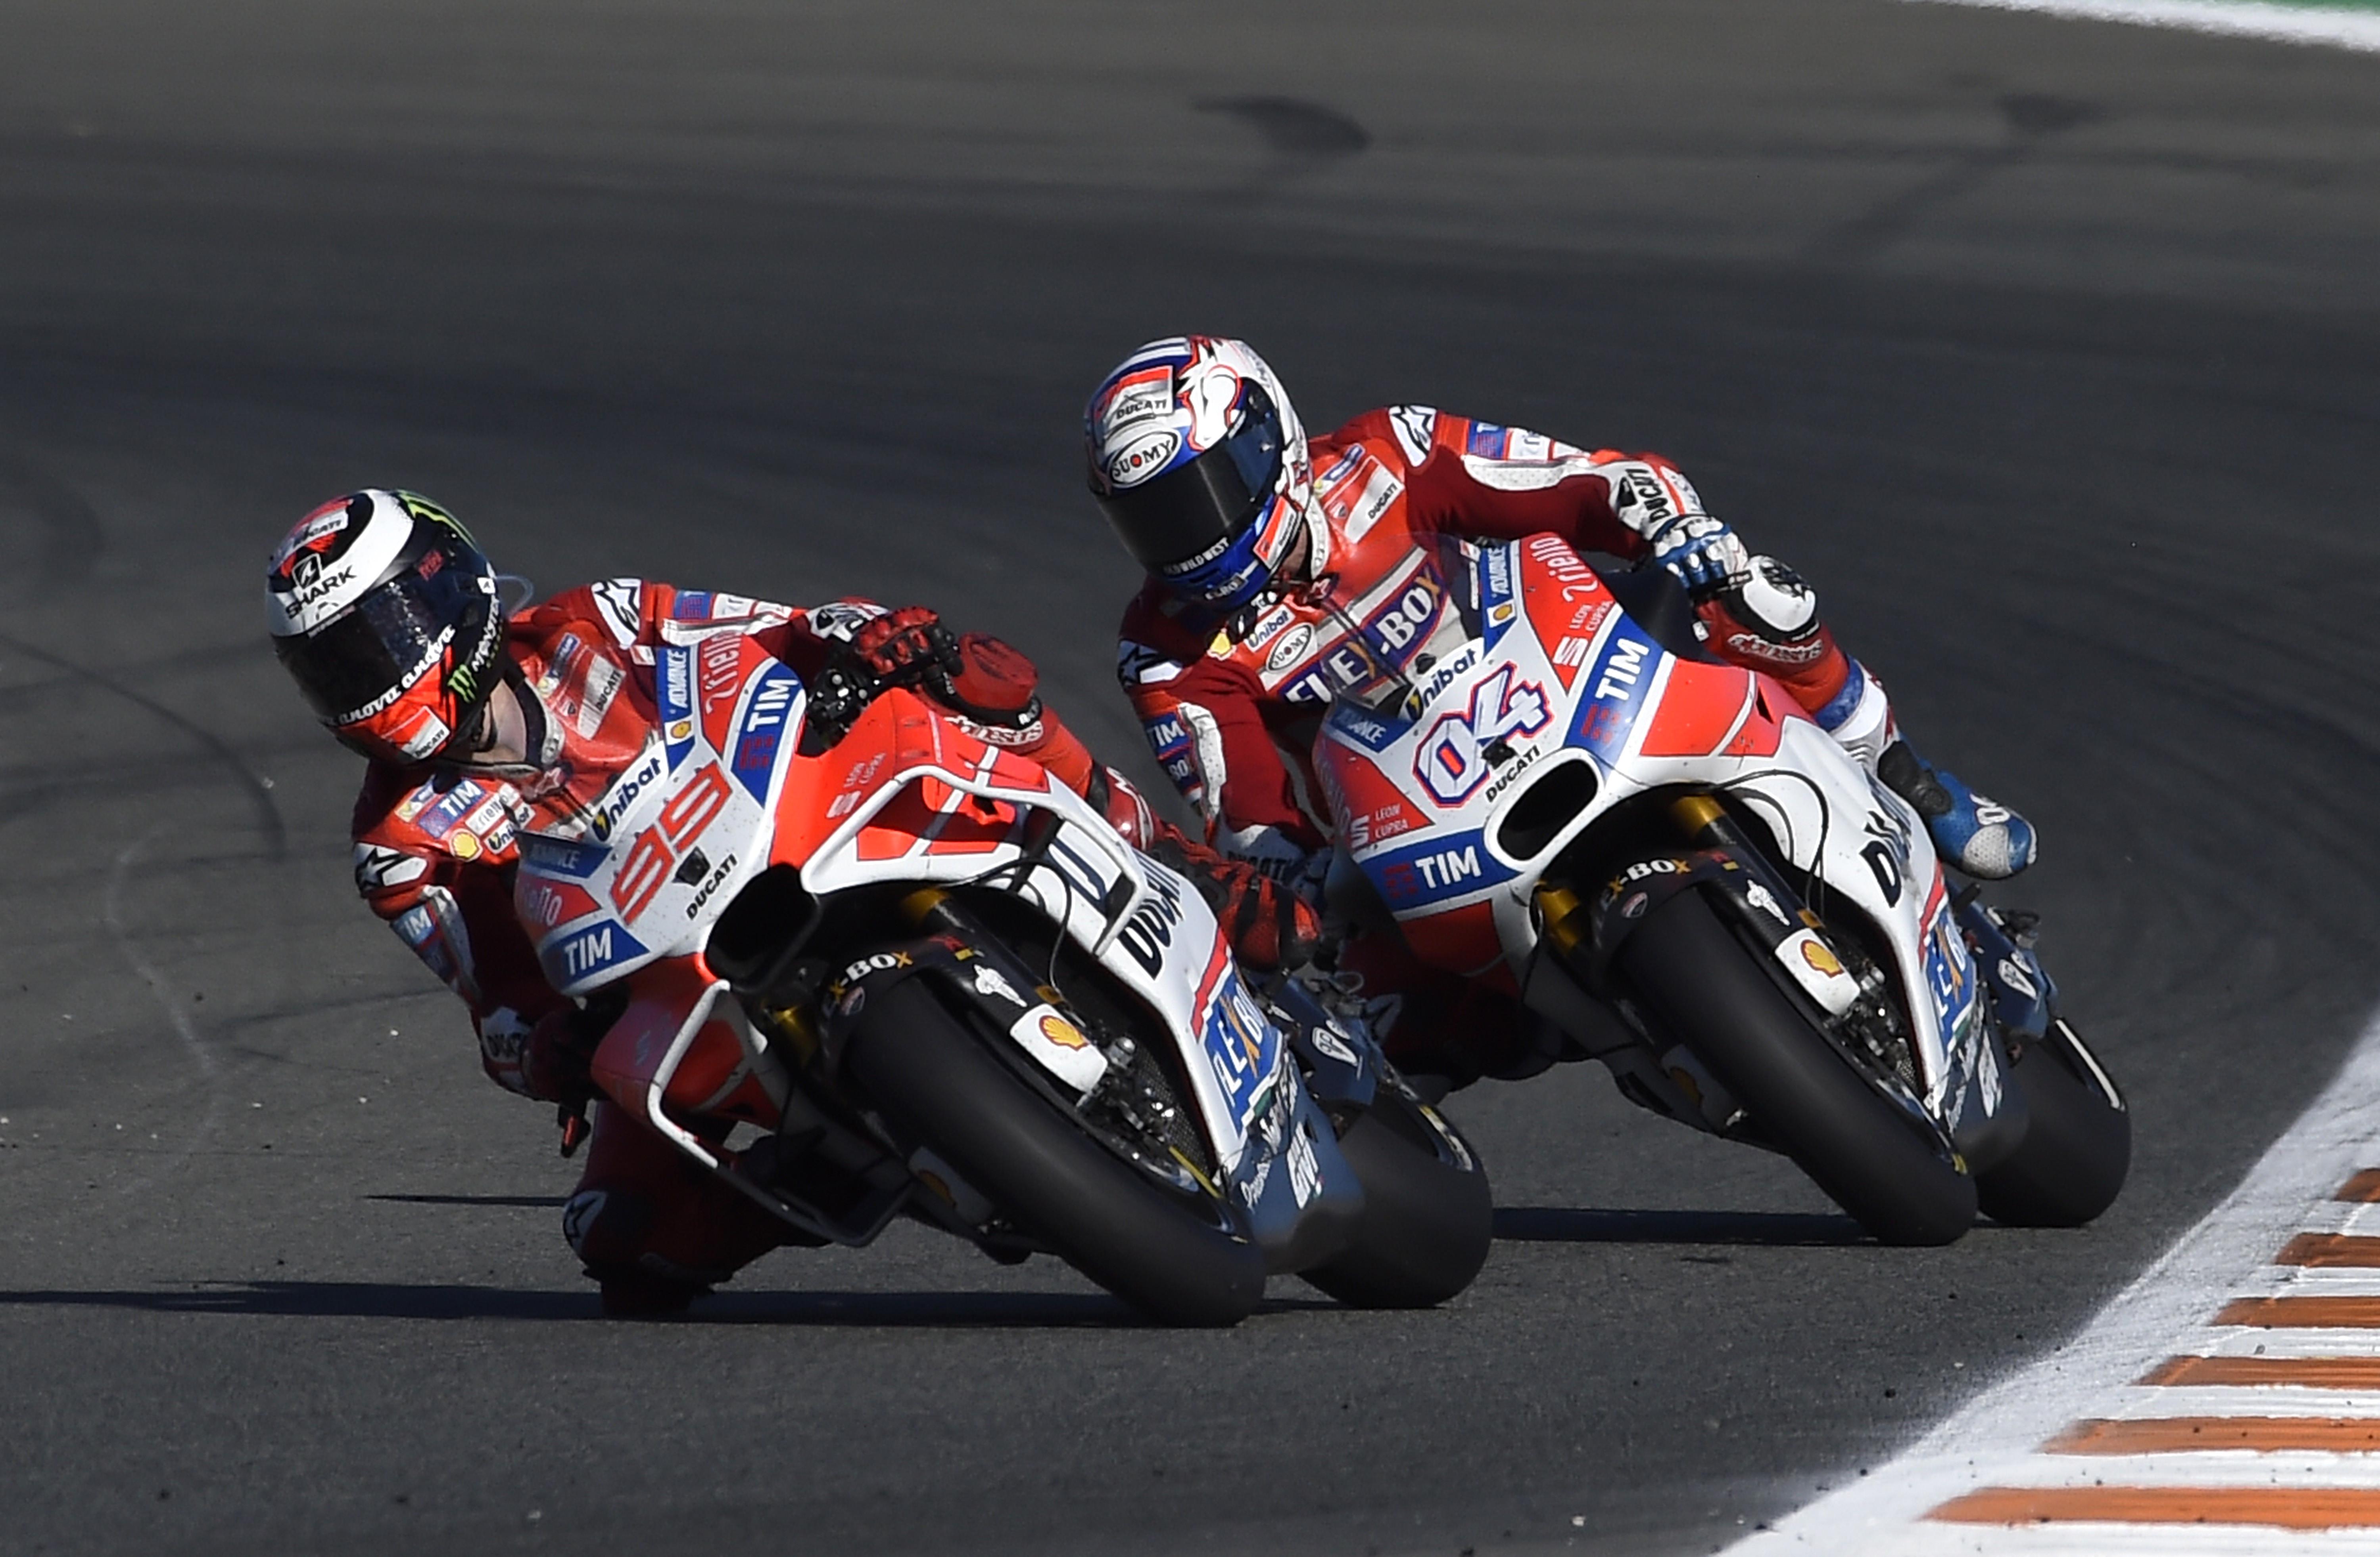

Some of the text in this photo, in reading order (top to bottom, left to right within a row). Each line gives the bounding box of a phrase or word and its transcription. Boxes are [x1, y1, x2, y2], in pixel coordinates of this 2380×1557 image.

[1115, 400, 1167, 420] DUCATI
[1113, 440, 1172, 477] SUOMY
[1368, 483, 1397, 519] DUCATI
[1205, 537, 1231, 561] WEST
[285, 564, 357, 620] SHARK
[1271, 628, 1310, 666] SUOMY
[595, 670, 622, 712] DUCATI
[1595, 638, 1650, 701] TIM
[747, 678, 799, 733] TIM
[415, 728, 445, 756] DUCATI
[1413, 662, 1554, 808] 04
[1485, 745, 1541, 803] DUCATI
[439, 779, 481, 817] TIM
[487, 805, 531, 852] Uniat
[610, 760, 733, 926] 99
[685, 853, 738, 920] DUCATI
[1414, 845, 1482, 889] TIM
[405, 908, 434, 938] IM
[564, 927, 612, 977] TIM
